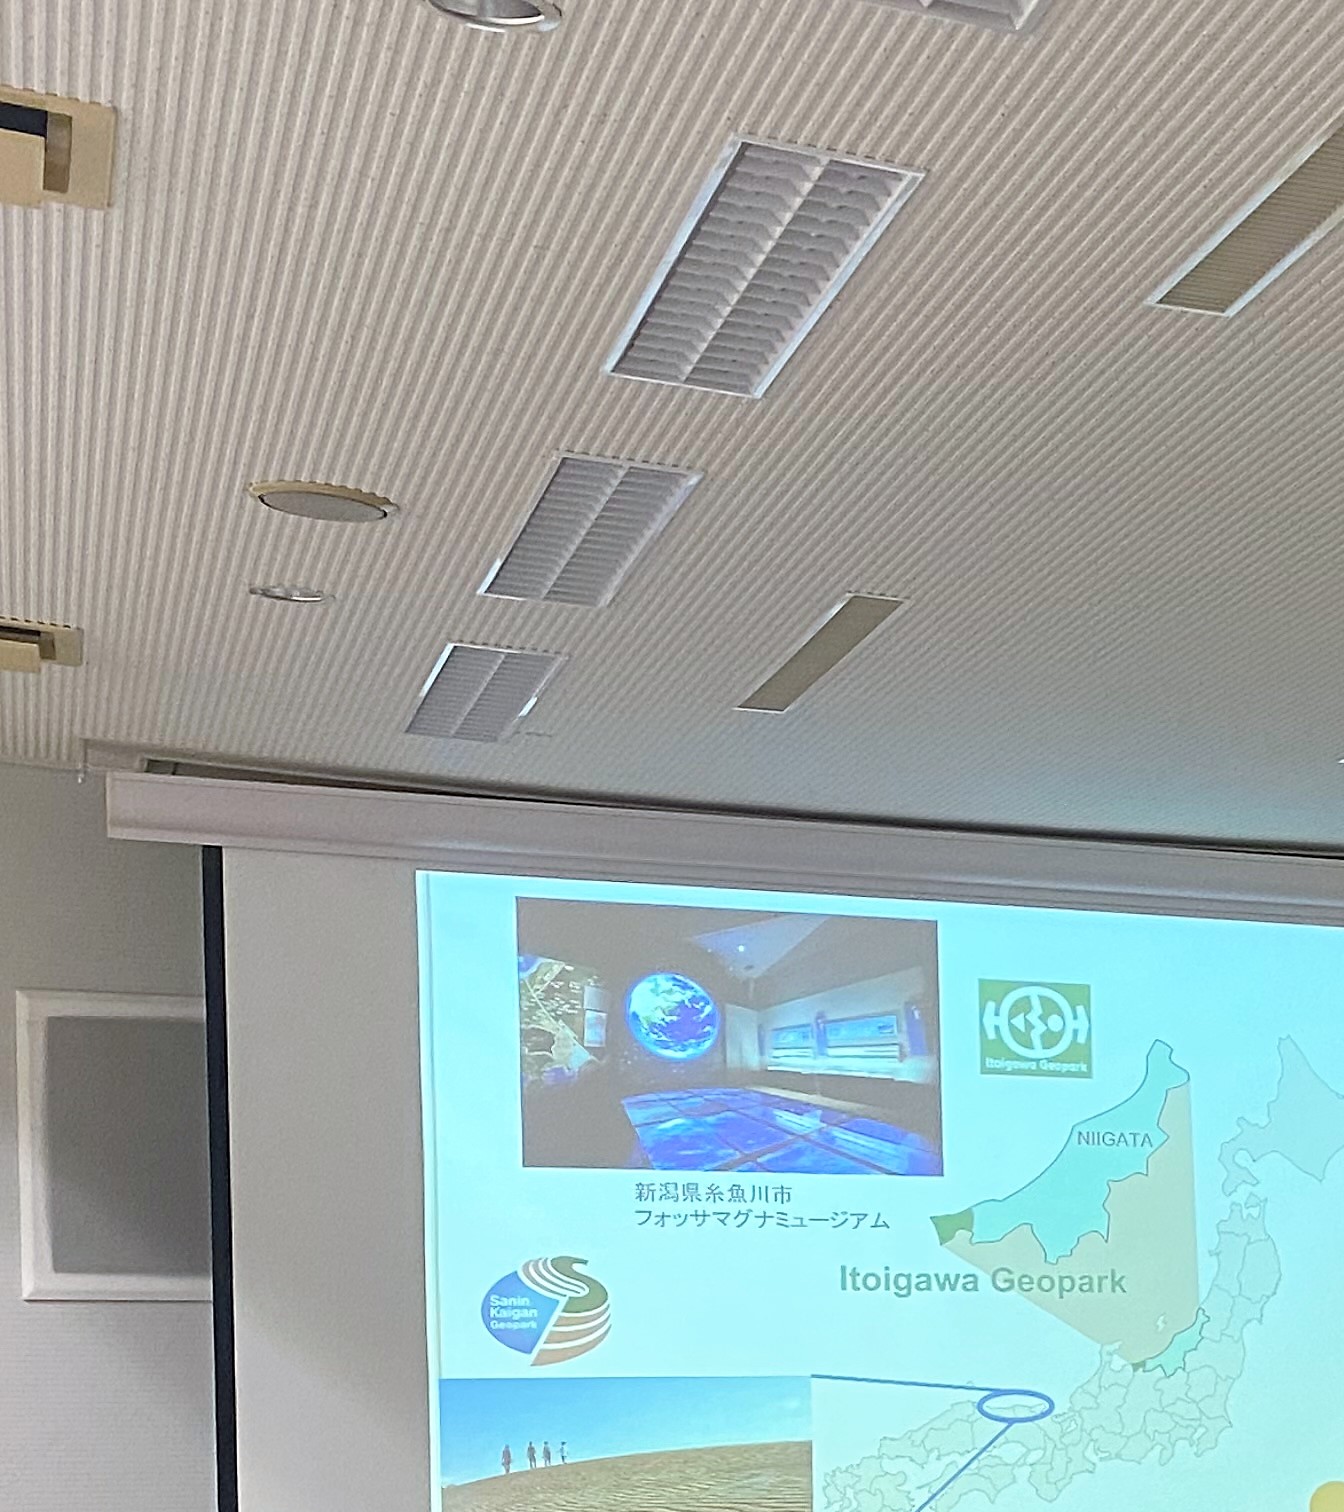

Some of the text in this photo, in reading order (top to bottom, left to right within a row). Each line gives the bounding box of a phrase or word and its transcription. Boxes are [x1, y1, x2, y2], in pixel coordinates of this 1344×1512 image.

[985, 1057, 1087, 1072] Itoigawa Geopark
[1077, 1131, 1153, 1147] NIIGATA
[635, 1182, 793, 1204] 新潟県糸魚川市
[634, 1209, 890, 1230] フォッサマグナミュージアム
[840, 1265, 1127, 1299] Itoigawa Geopark
[490, 1295, 530, 1306] Sanin
[490, 1306, 538, 1320] Kaigan
